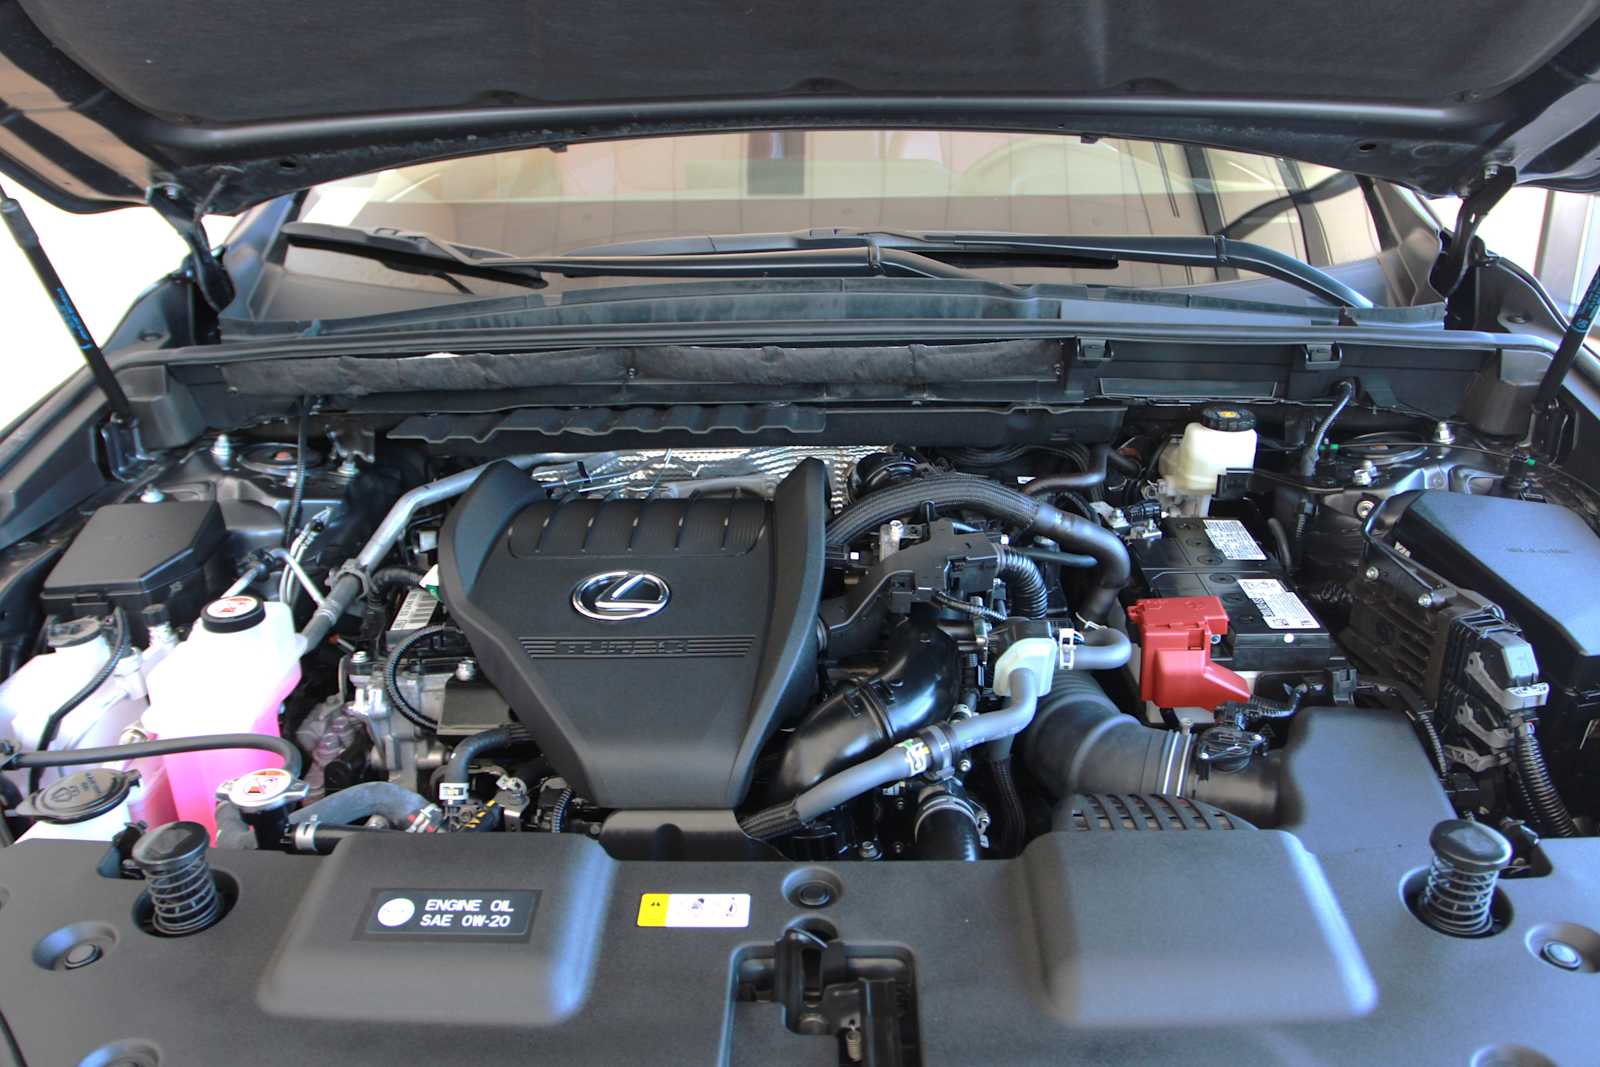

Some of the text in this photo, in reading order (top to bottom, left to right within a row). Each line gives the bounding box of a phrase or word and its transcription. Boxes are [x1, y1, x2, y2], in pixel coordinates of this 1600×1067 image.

[558, 639, 684, 655] TURBO
[424, 899, 515, 912] ENGINE OIL
[420, 914, 511, 928] SAE 0W-20
